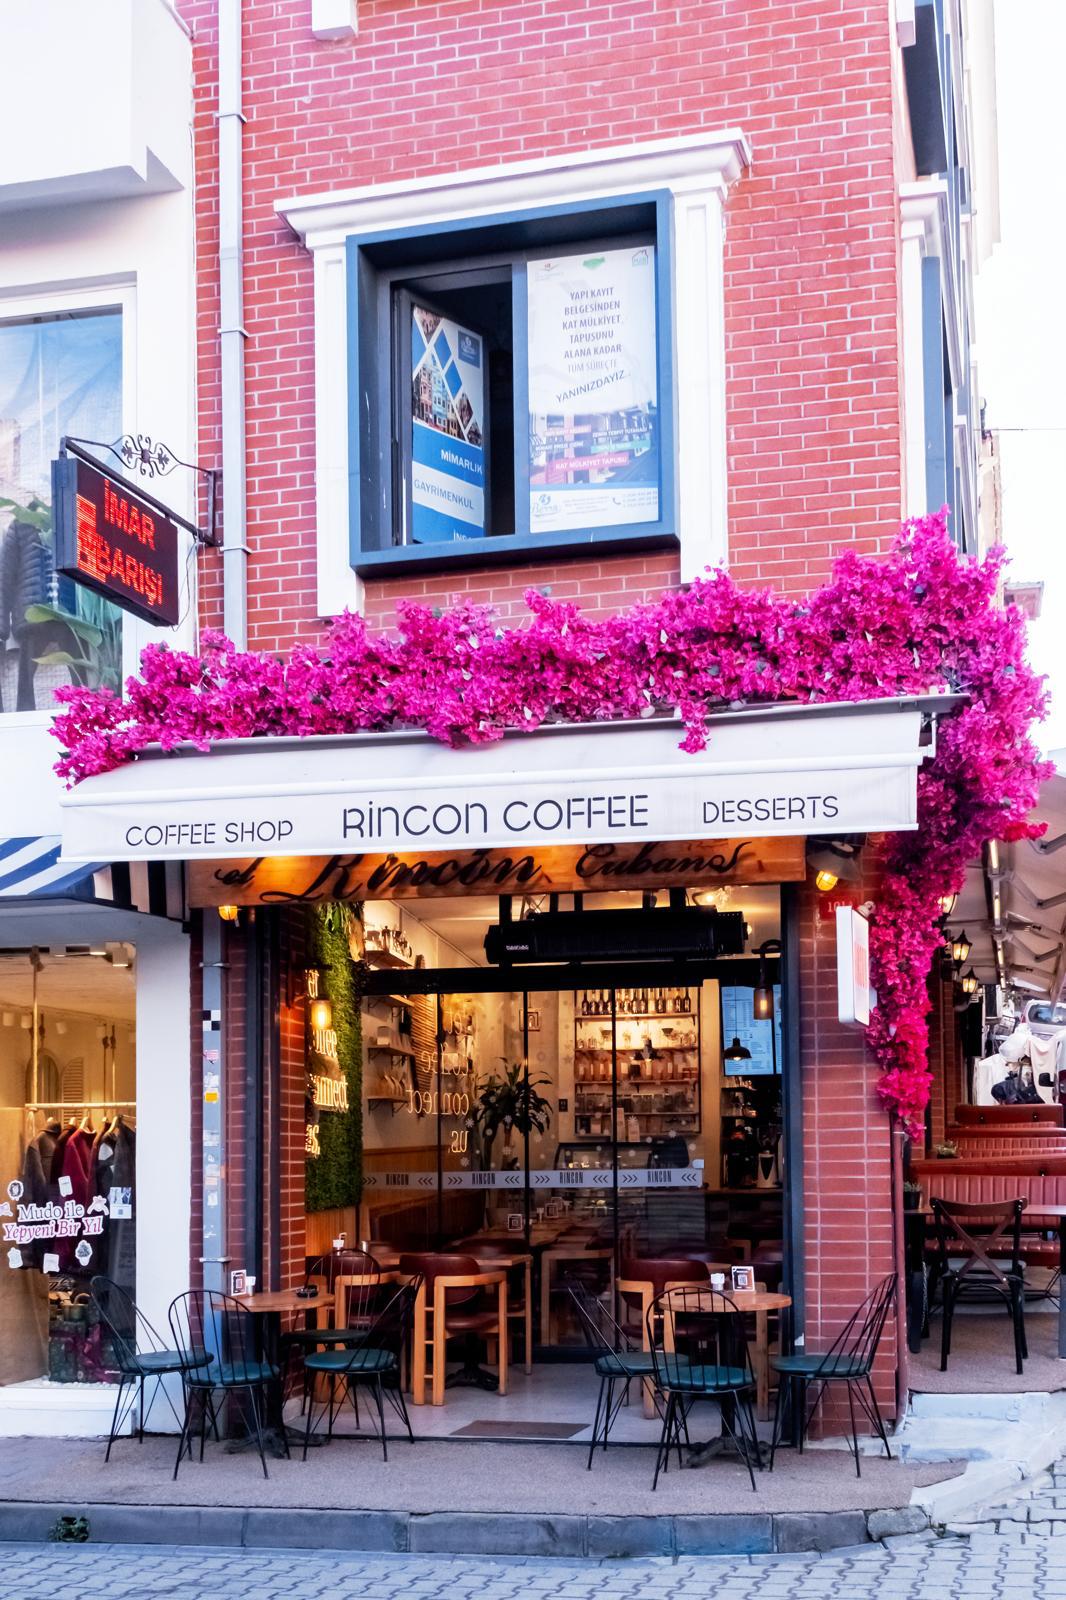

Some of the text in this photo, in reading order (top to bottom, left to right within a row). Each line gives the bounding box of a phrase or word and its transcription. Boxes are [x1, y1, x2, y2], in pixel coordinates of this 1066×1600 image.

[570, 287, 614, 301] YAPI KAYIT
[564, 300, 621, 315] BELGESİNDEN
[562, 314, 621, 331] KAT MÜLKİYET
[570, 330, 614, 344] TAPUSUNU
[564, 343, 622, 359] ALANA KADAR
[440, 449, 482, 474] MİMARLIK
[414, 479, 474, 508] GAYRİMENKUL
[104, 478, 156, 551] İMAR
[503, 794, 649, 832] COFFEE
[703, 795, 839, 825] DESSERTS
[125, 819, 294, 847] COFFEE SHOP
[19, 1200, 84, 1221] Mudo ile
[4, 1221, 56, 1242] Yepyeni
[58, 1219, 82, 1237] Bir
